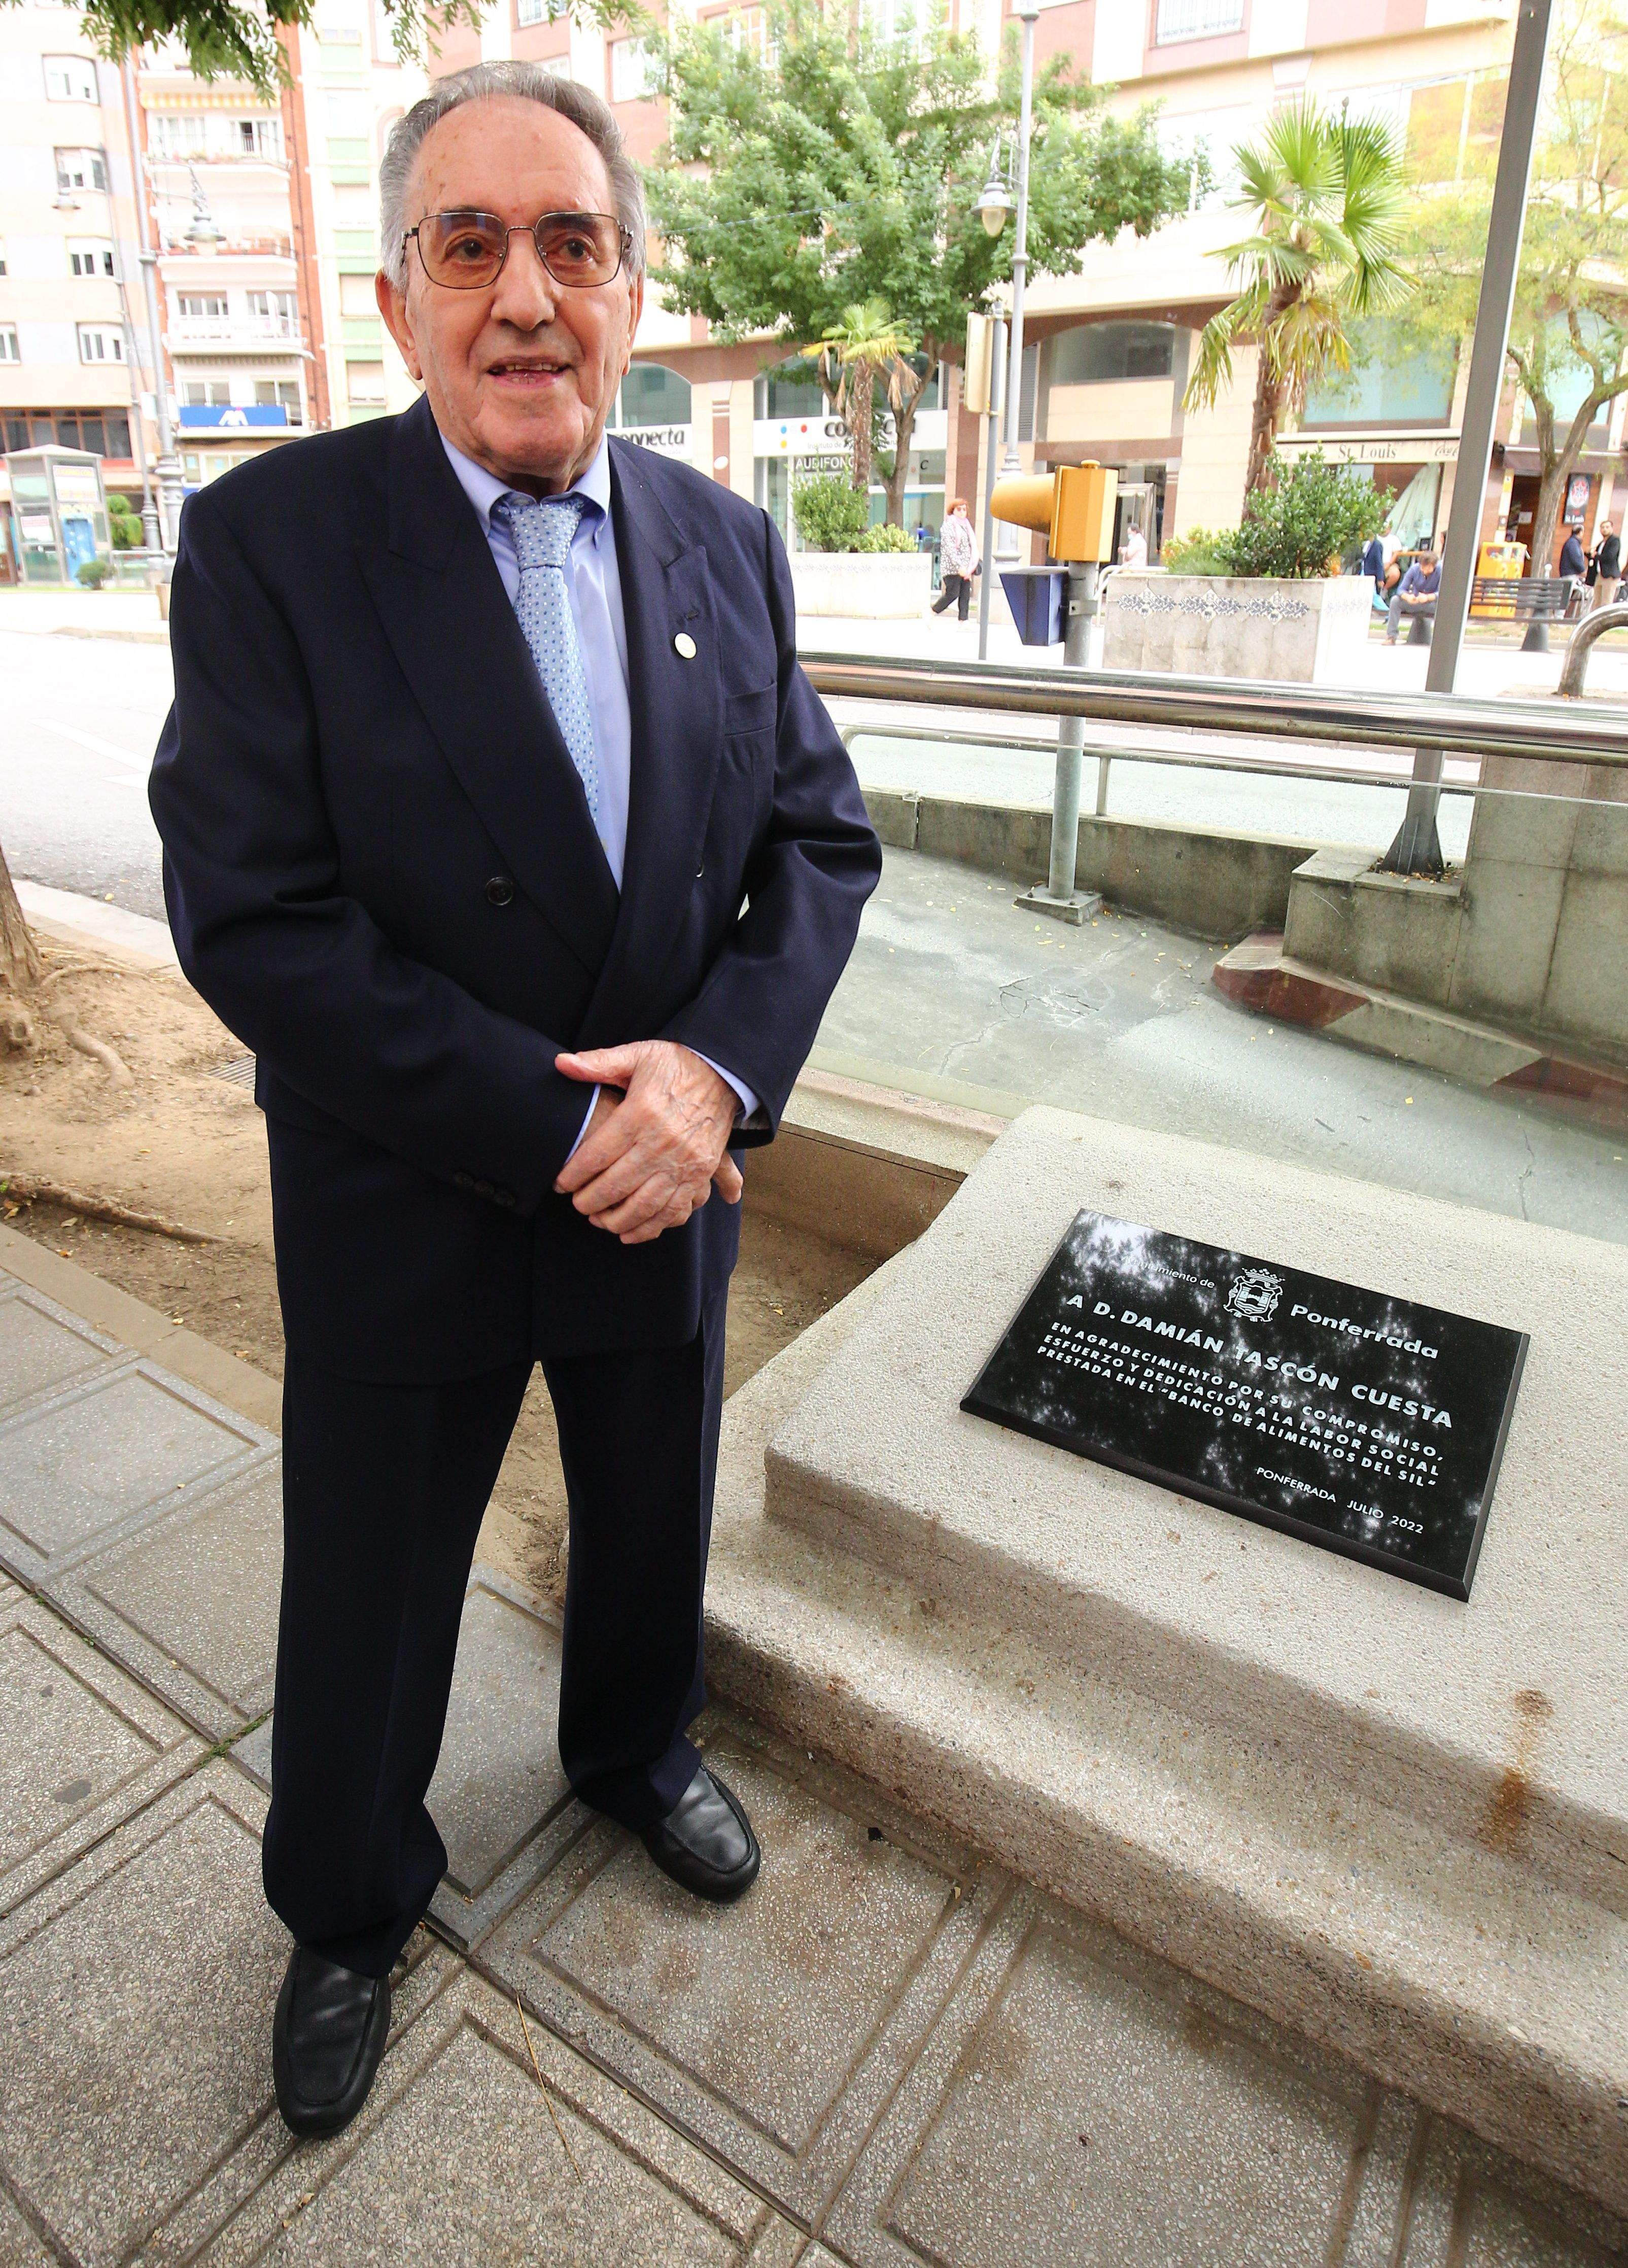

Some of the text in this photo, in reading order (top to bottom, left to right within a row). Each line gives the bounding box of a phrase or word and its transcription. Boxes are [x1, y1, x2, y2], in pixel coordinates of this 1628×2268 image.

[1360, 443, 1397, 459] Louis
[1200, 1278, 1215, 1288] de
[1290, 1304, 1439, 1359] Ponferrada
[1044, 1334, 1439, 1476] ESFUERZO Y DEDICACIÓN A LA LABOR SOCIAL
[1051, 1322, 1443, 1461] EN AGRADECIMIENTO POR SU COMPROMISO,
[1066, 1294, 1452, 1428] A D. DAMIÁN TASCÓN CUESTA
[1037, 1346, 1112, 1378] PRESTADA
[1115, 1373, 1136, 1386] EN
[1139, 1380, 1154, 1393] EL
[1232, 1412, 1253, 1427] DE
[1256, 1422, 1356, 1462] ALIMENTOS
[1361, 1456, 1391, 1476] DEL
[1256, 1467, 1424, 1534] PONFERRADA JULIO 2022
